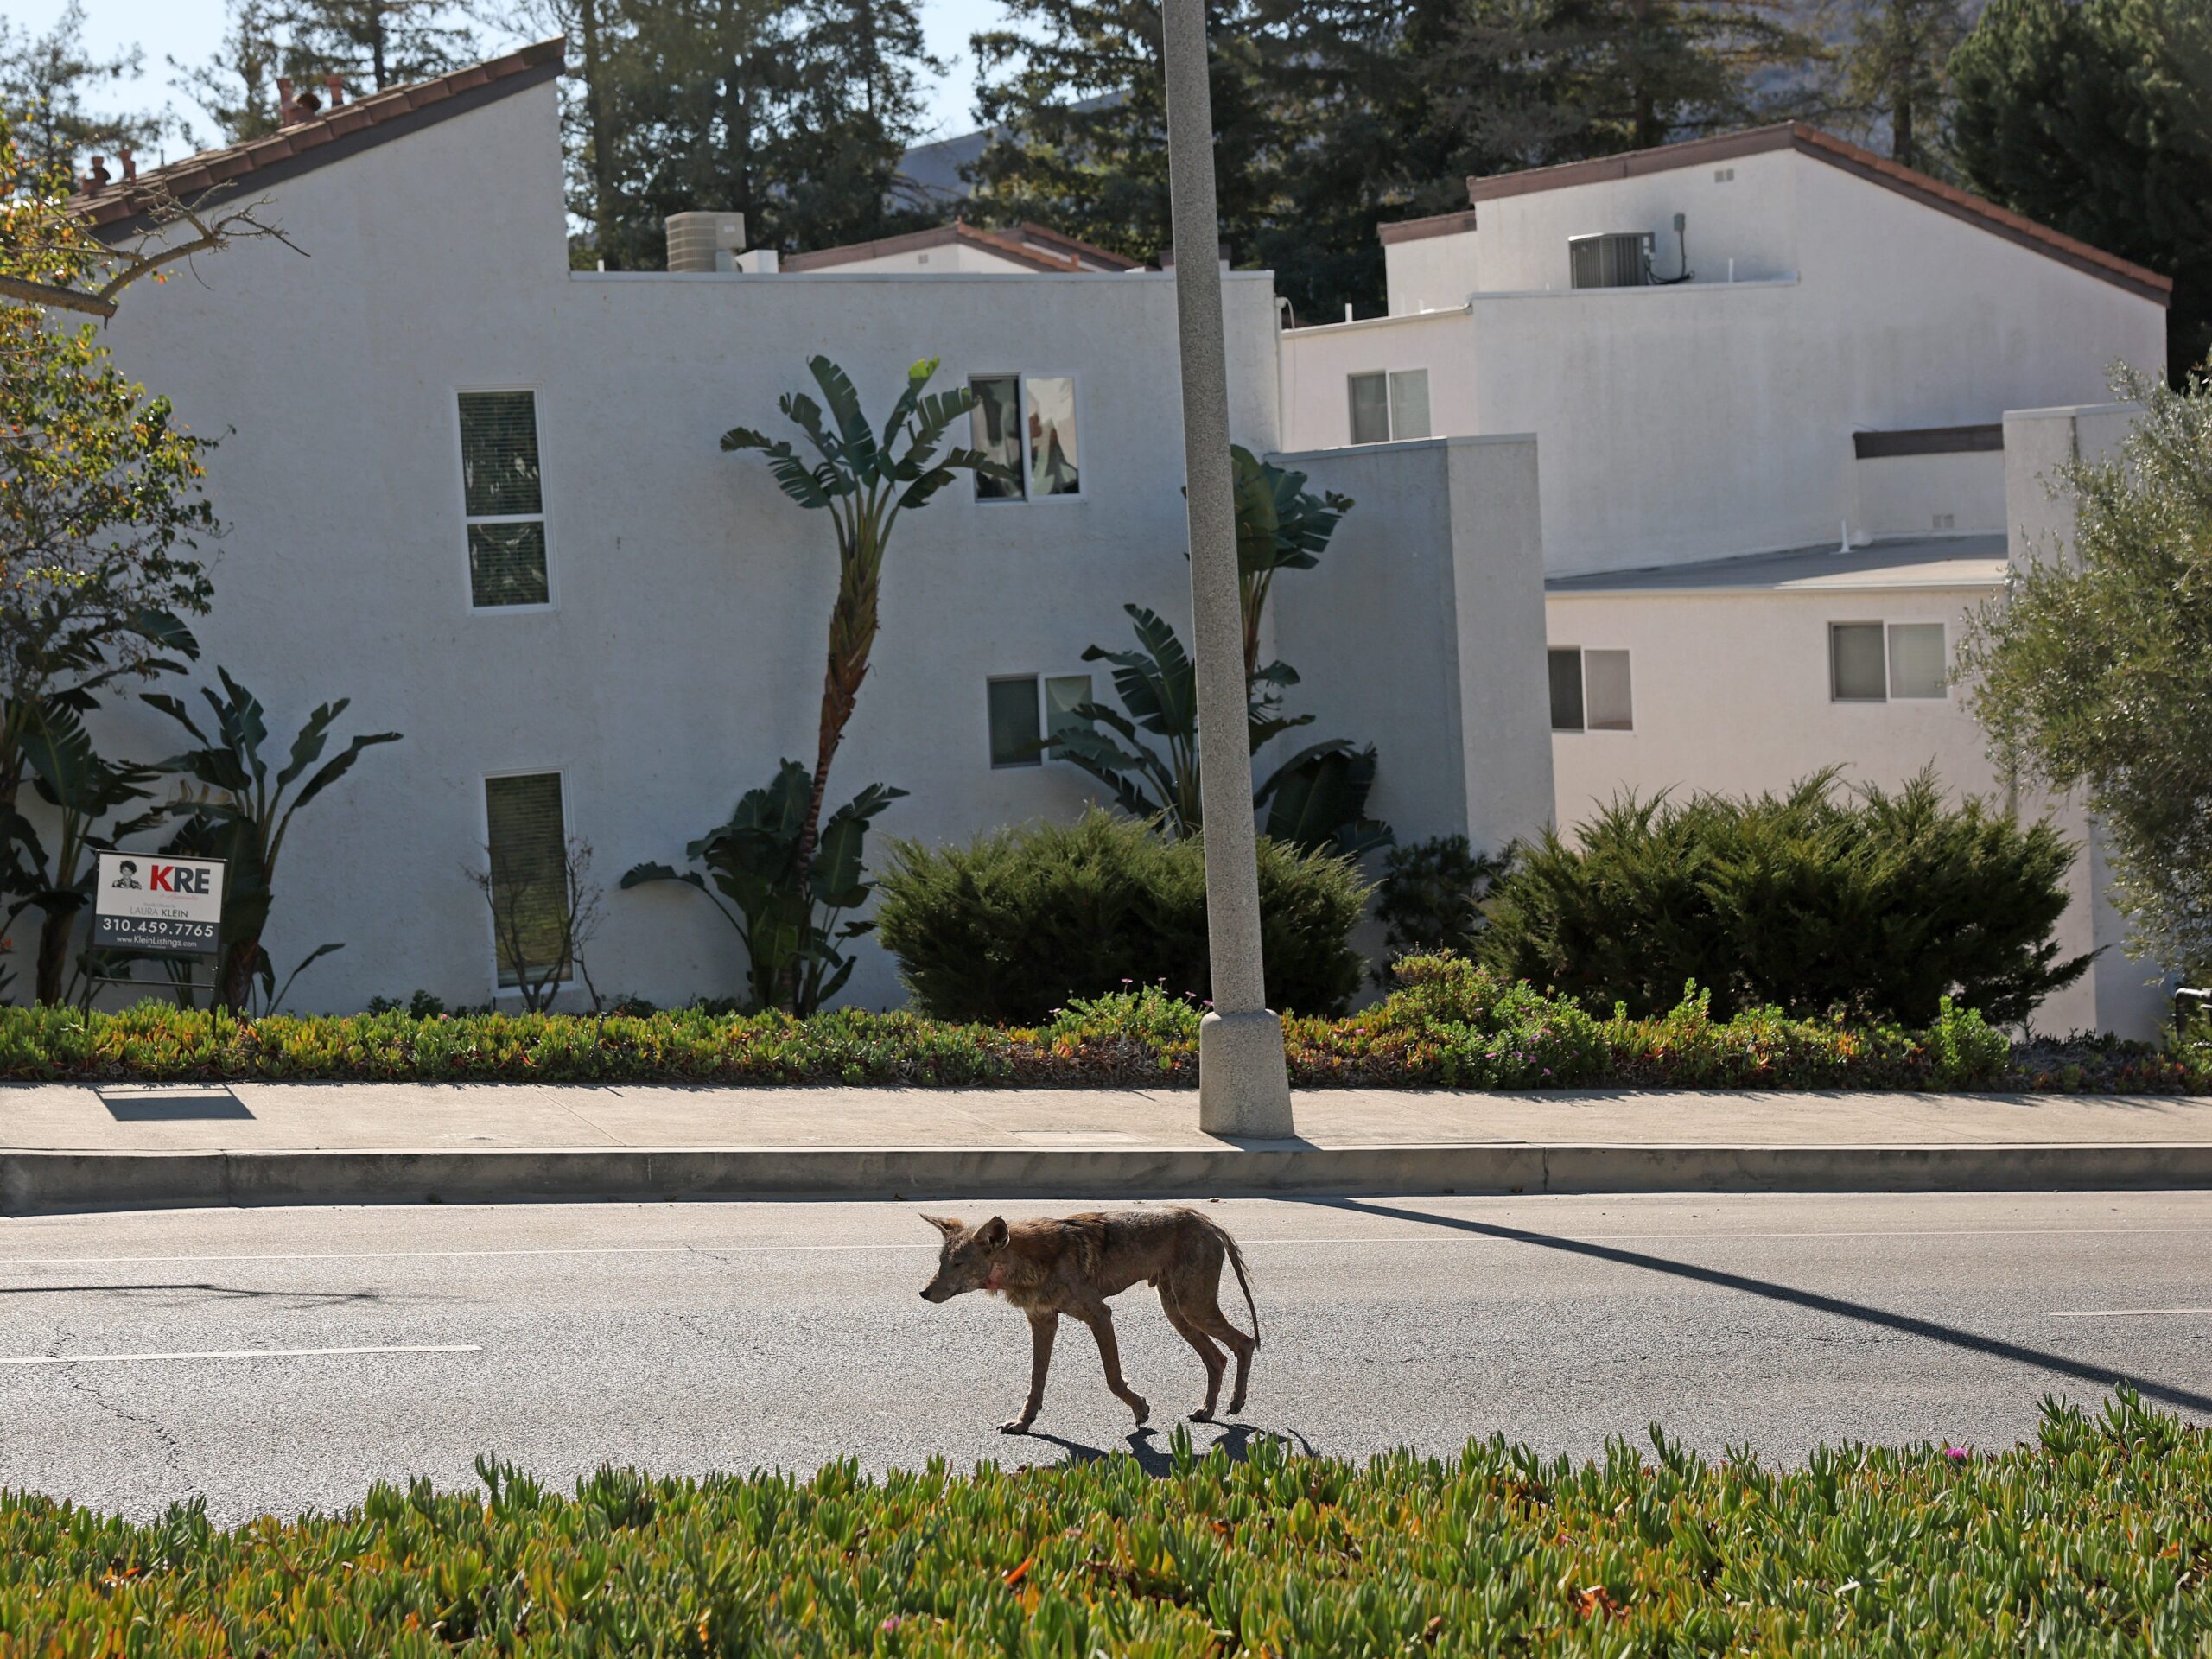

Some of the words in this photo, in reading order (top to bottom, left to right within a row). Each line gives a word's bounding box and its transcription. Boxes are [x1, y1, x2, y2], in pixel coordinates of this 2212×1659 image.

[150, 864, 210, 894] KRE
[130, 906, 158, 917] LAURA
[161, 908, 188, 918] KLEIN
[102, 918, 213, 938] 310.459.7765
[117, 935, 197, 948] www.KleinListings.com
